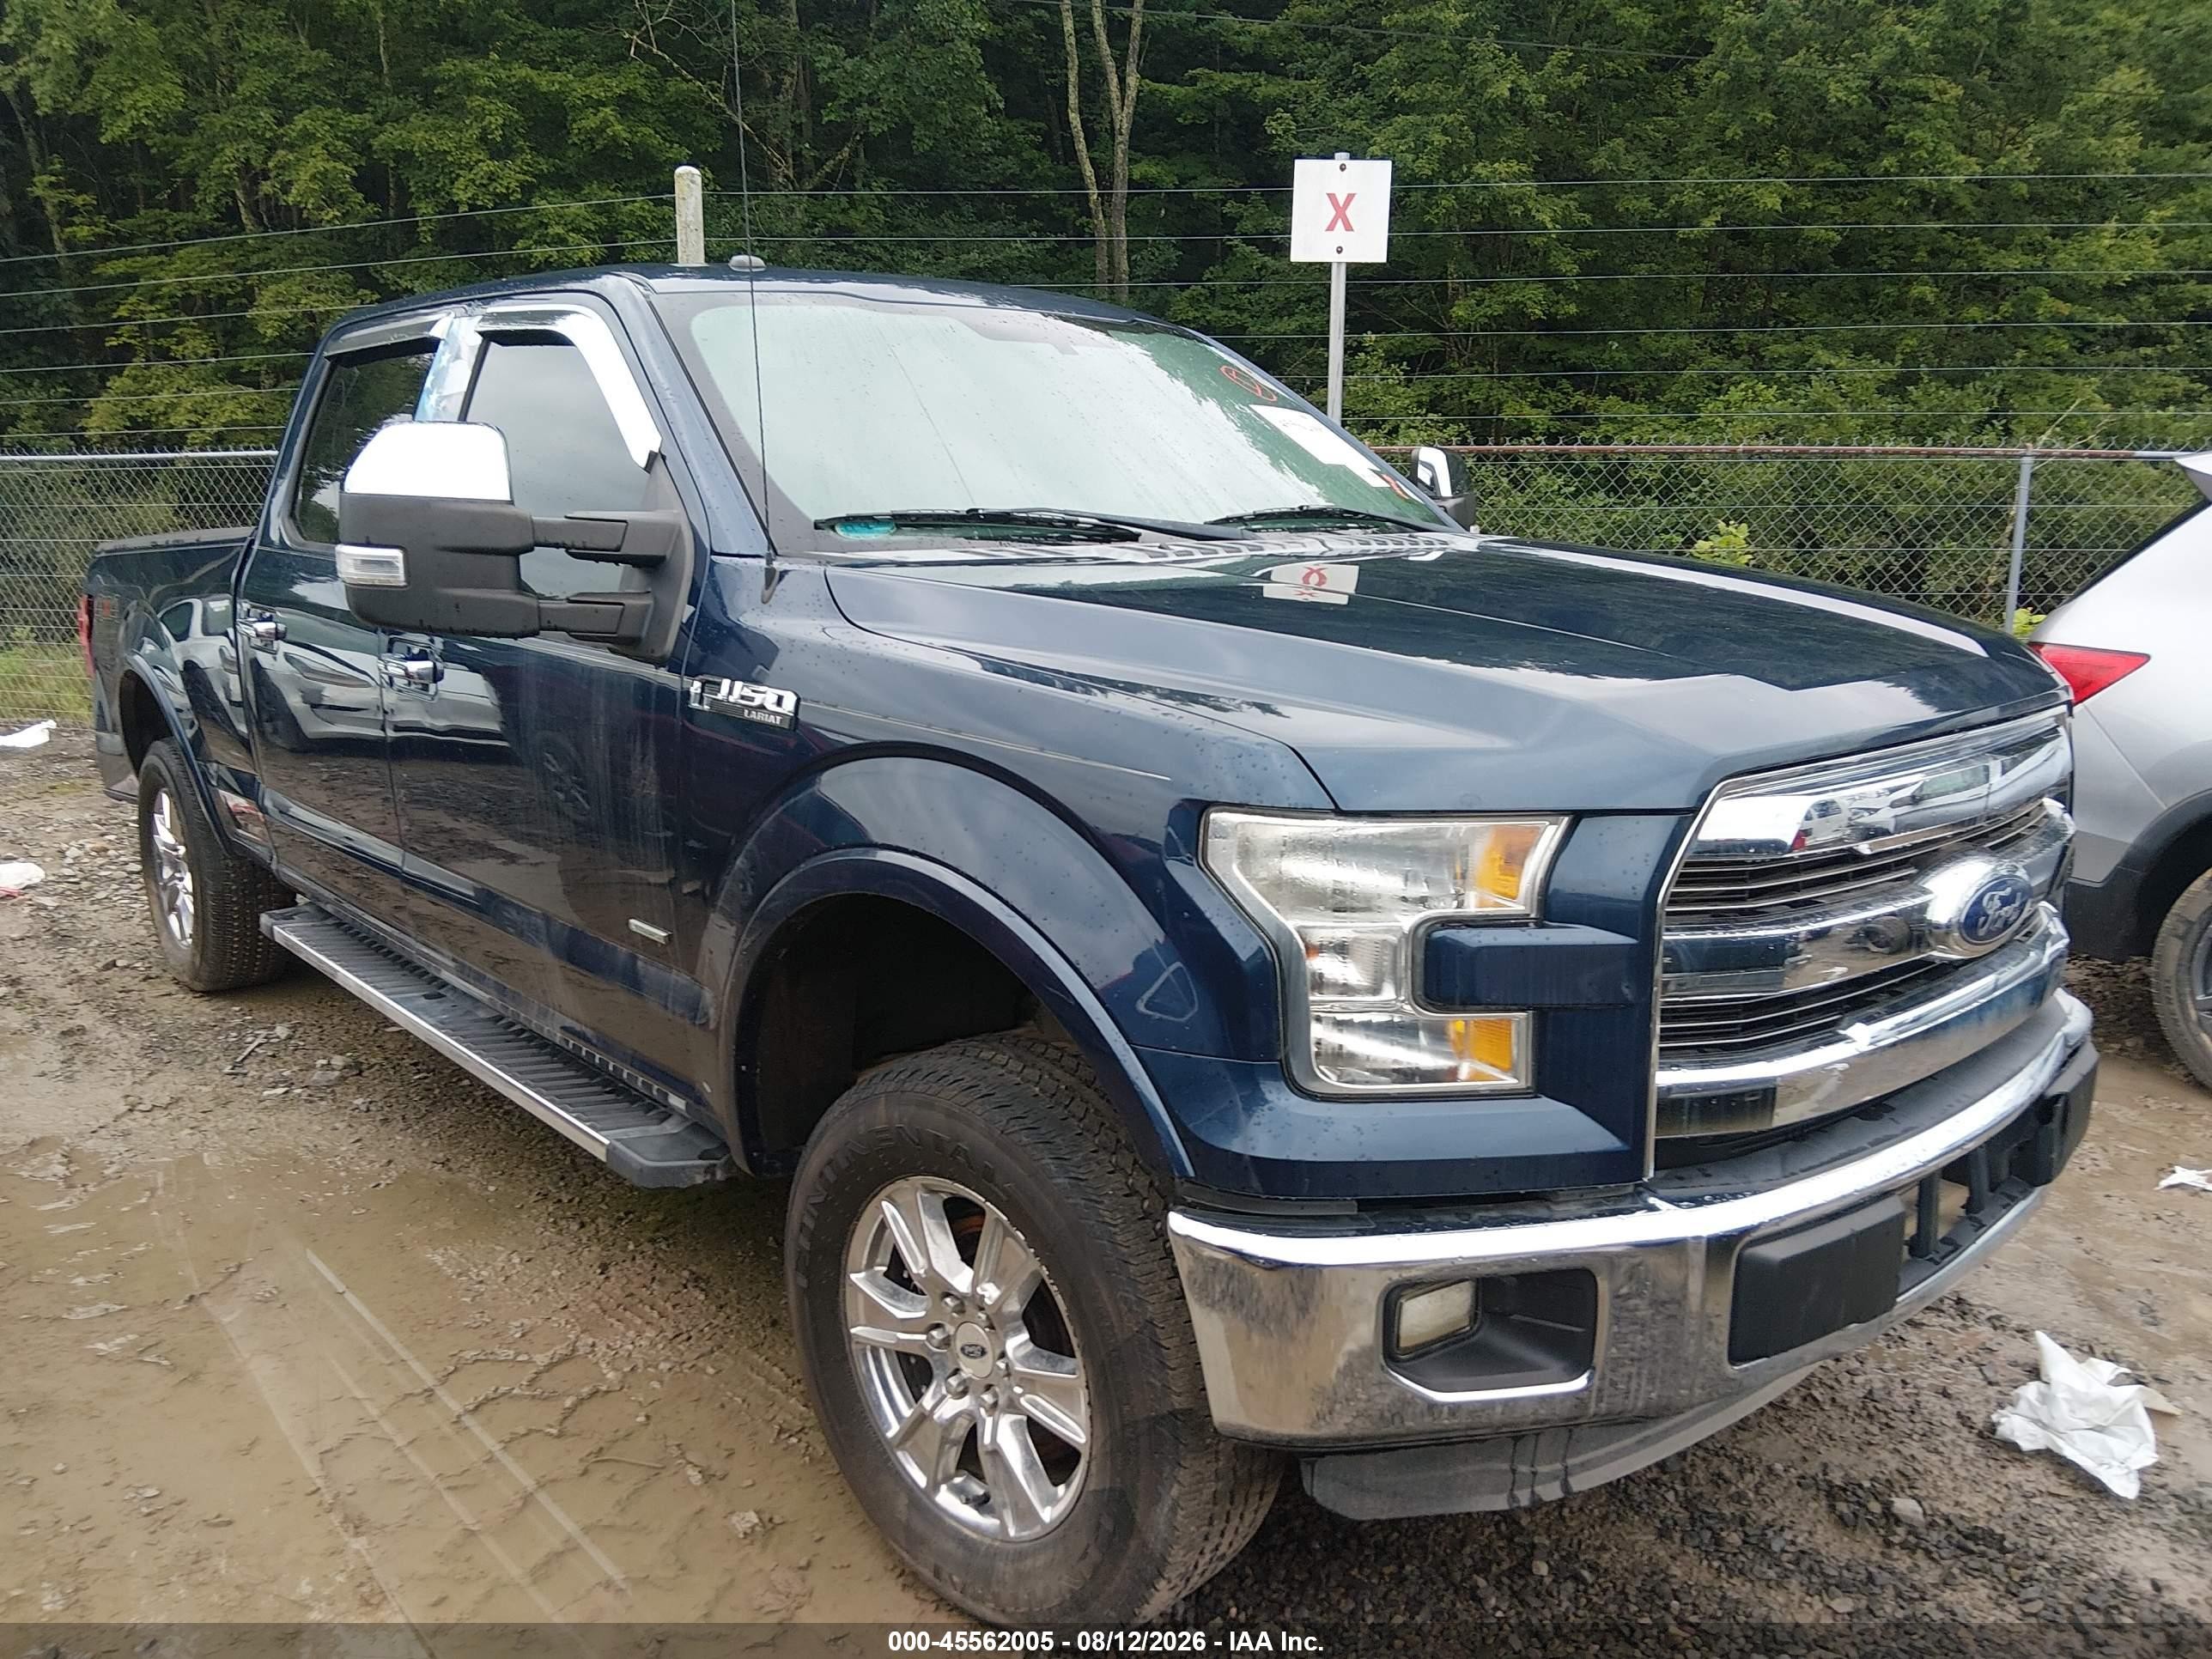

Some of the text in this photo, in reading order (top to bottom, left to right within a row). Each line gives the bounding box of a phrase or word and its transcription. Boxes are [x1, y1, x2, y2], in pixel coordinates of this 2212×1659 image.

[1325, 192, 1357, 232] X
[743, 709, 783, 725] LARIAT
[1978, 887, 2022, 937] Ford
